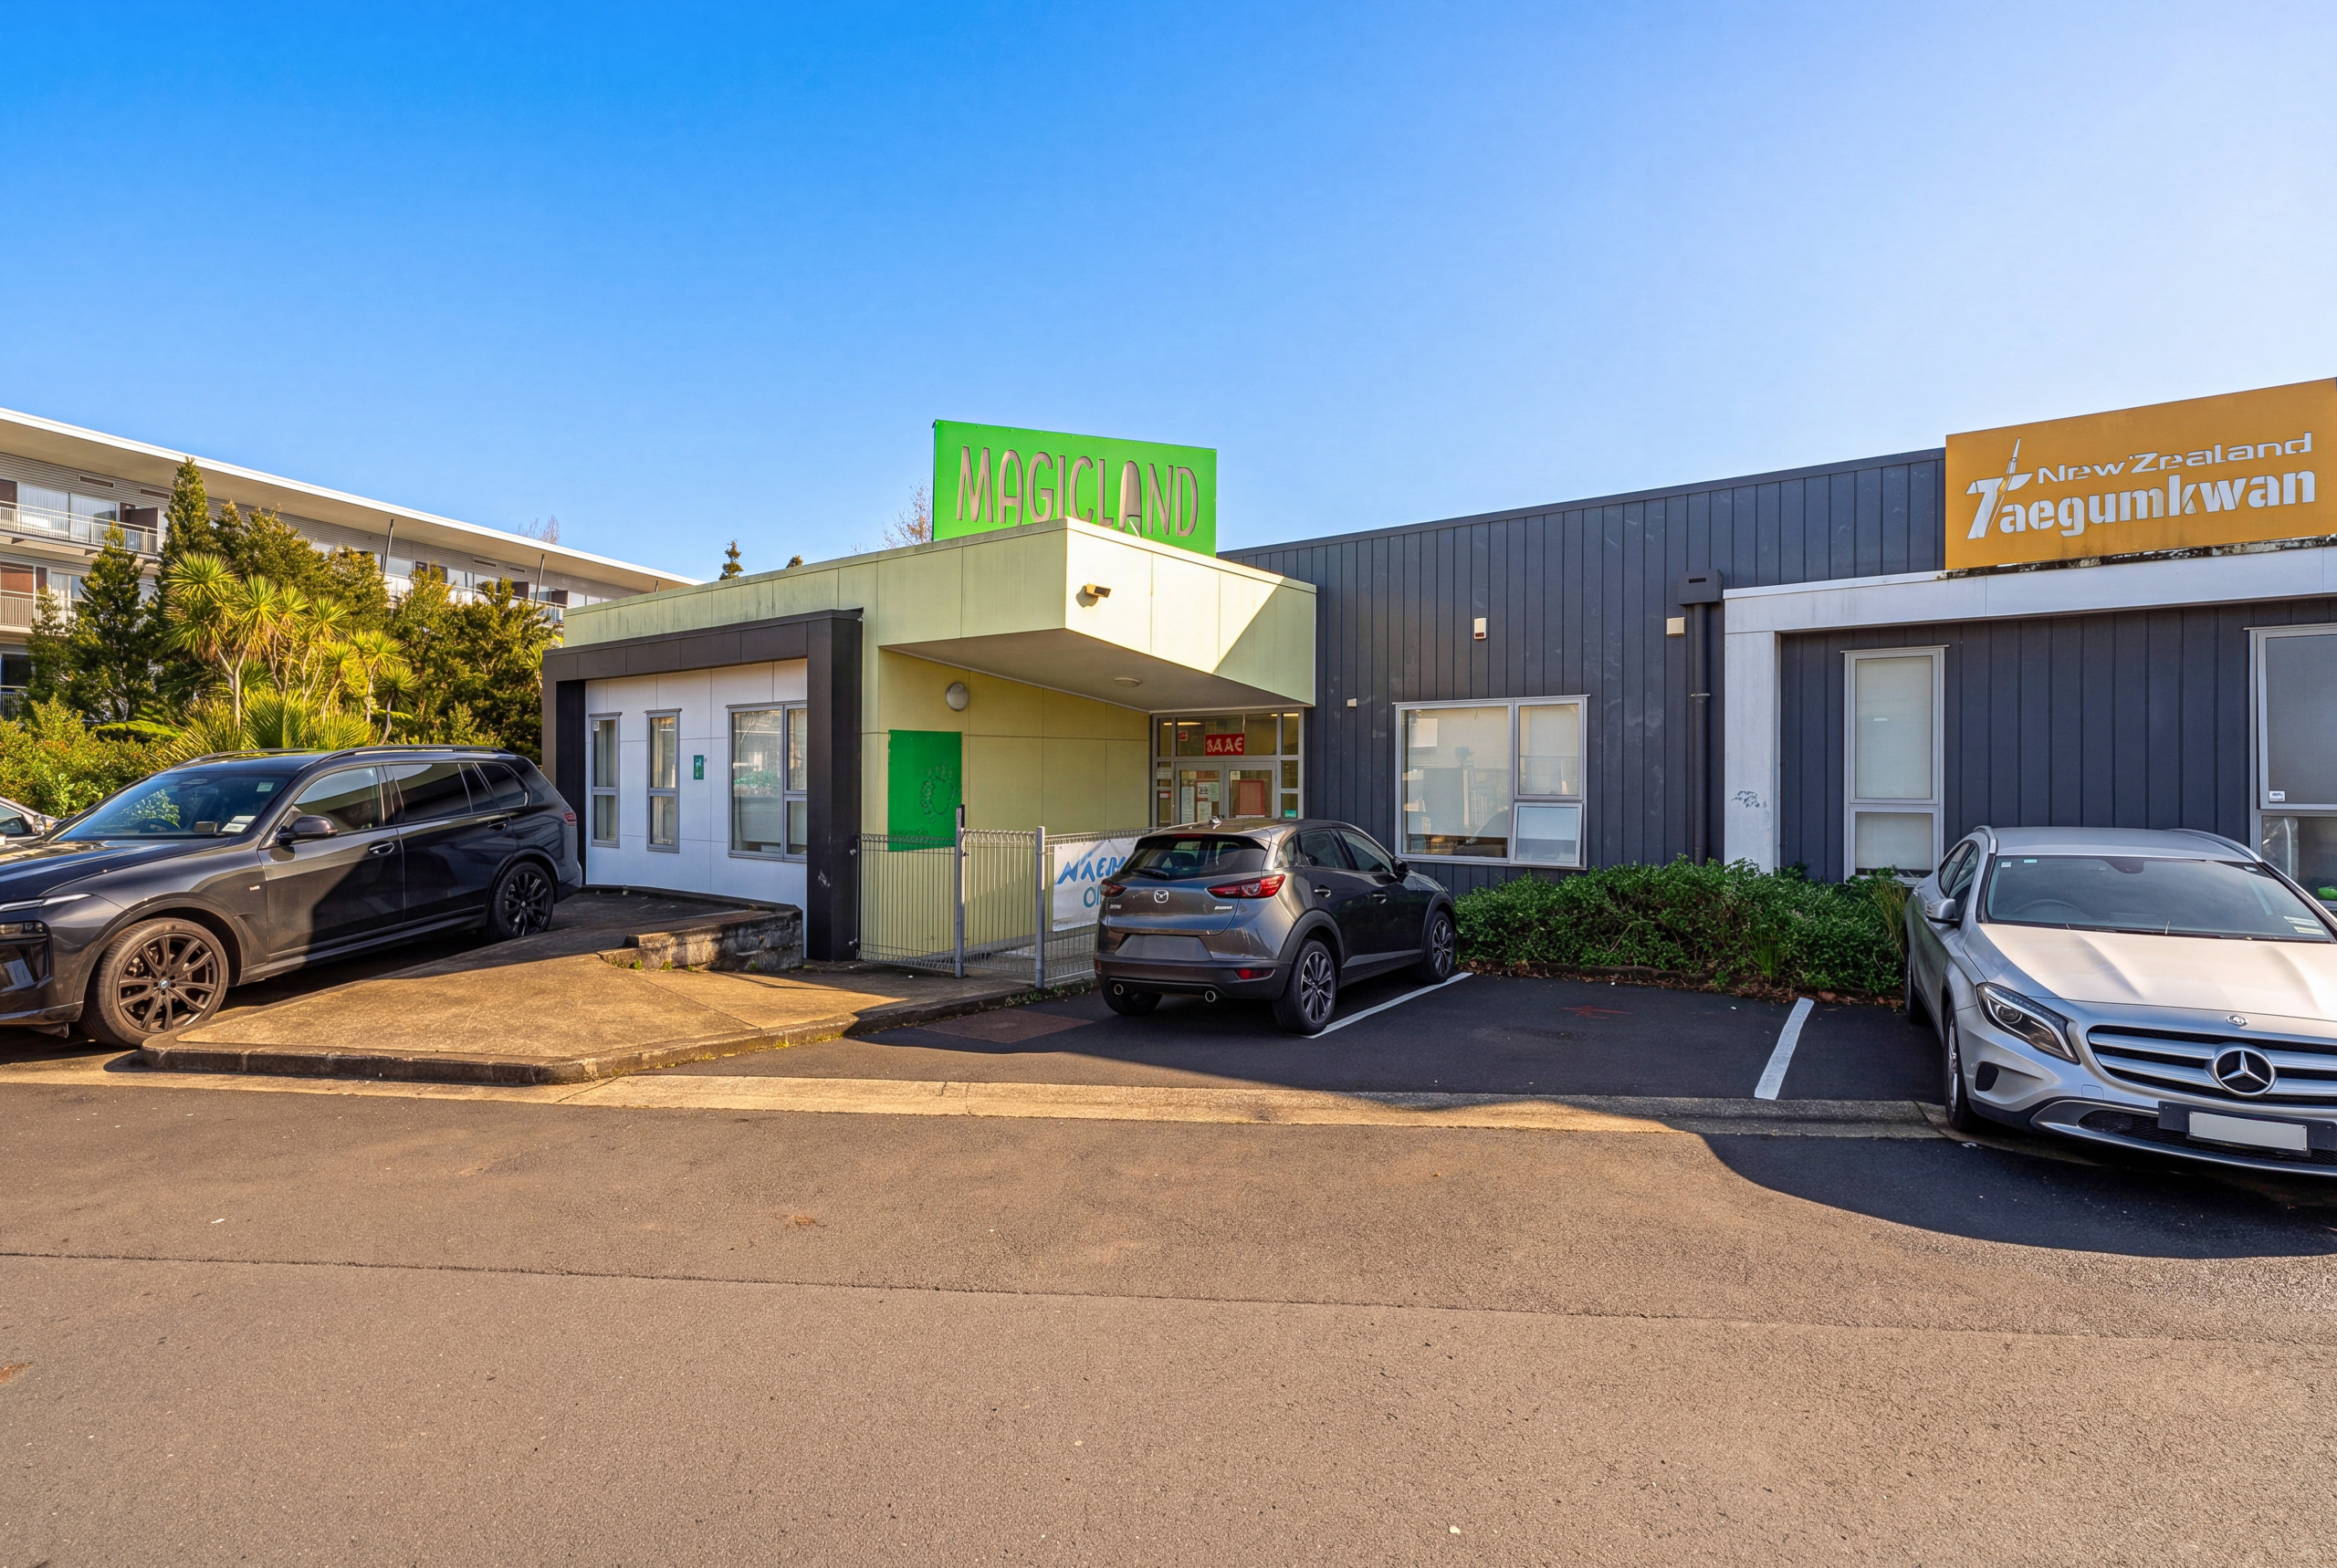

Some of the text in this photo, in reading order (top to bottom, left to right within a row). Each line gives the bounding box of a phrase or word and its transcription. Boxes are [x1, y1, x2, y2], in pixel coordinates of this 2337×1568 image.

[956, 445, 1199, 537] MAGICLAND
[2038, 431, 2313, 485] New Zealand
[1965, 464, 2317, 540] Taegumkwan
